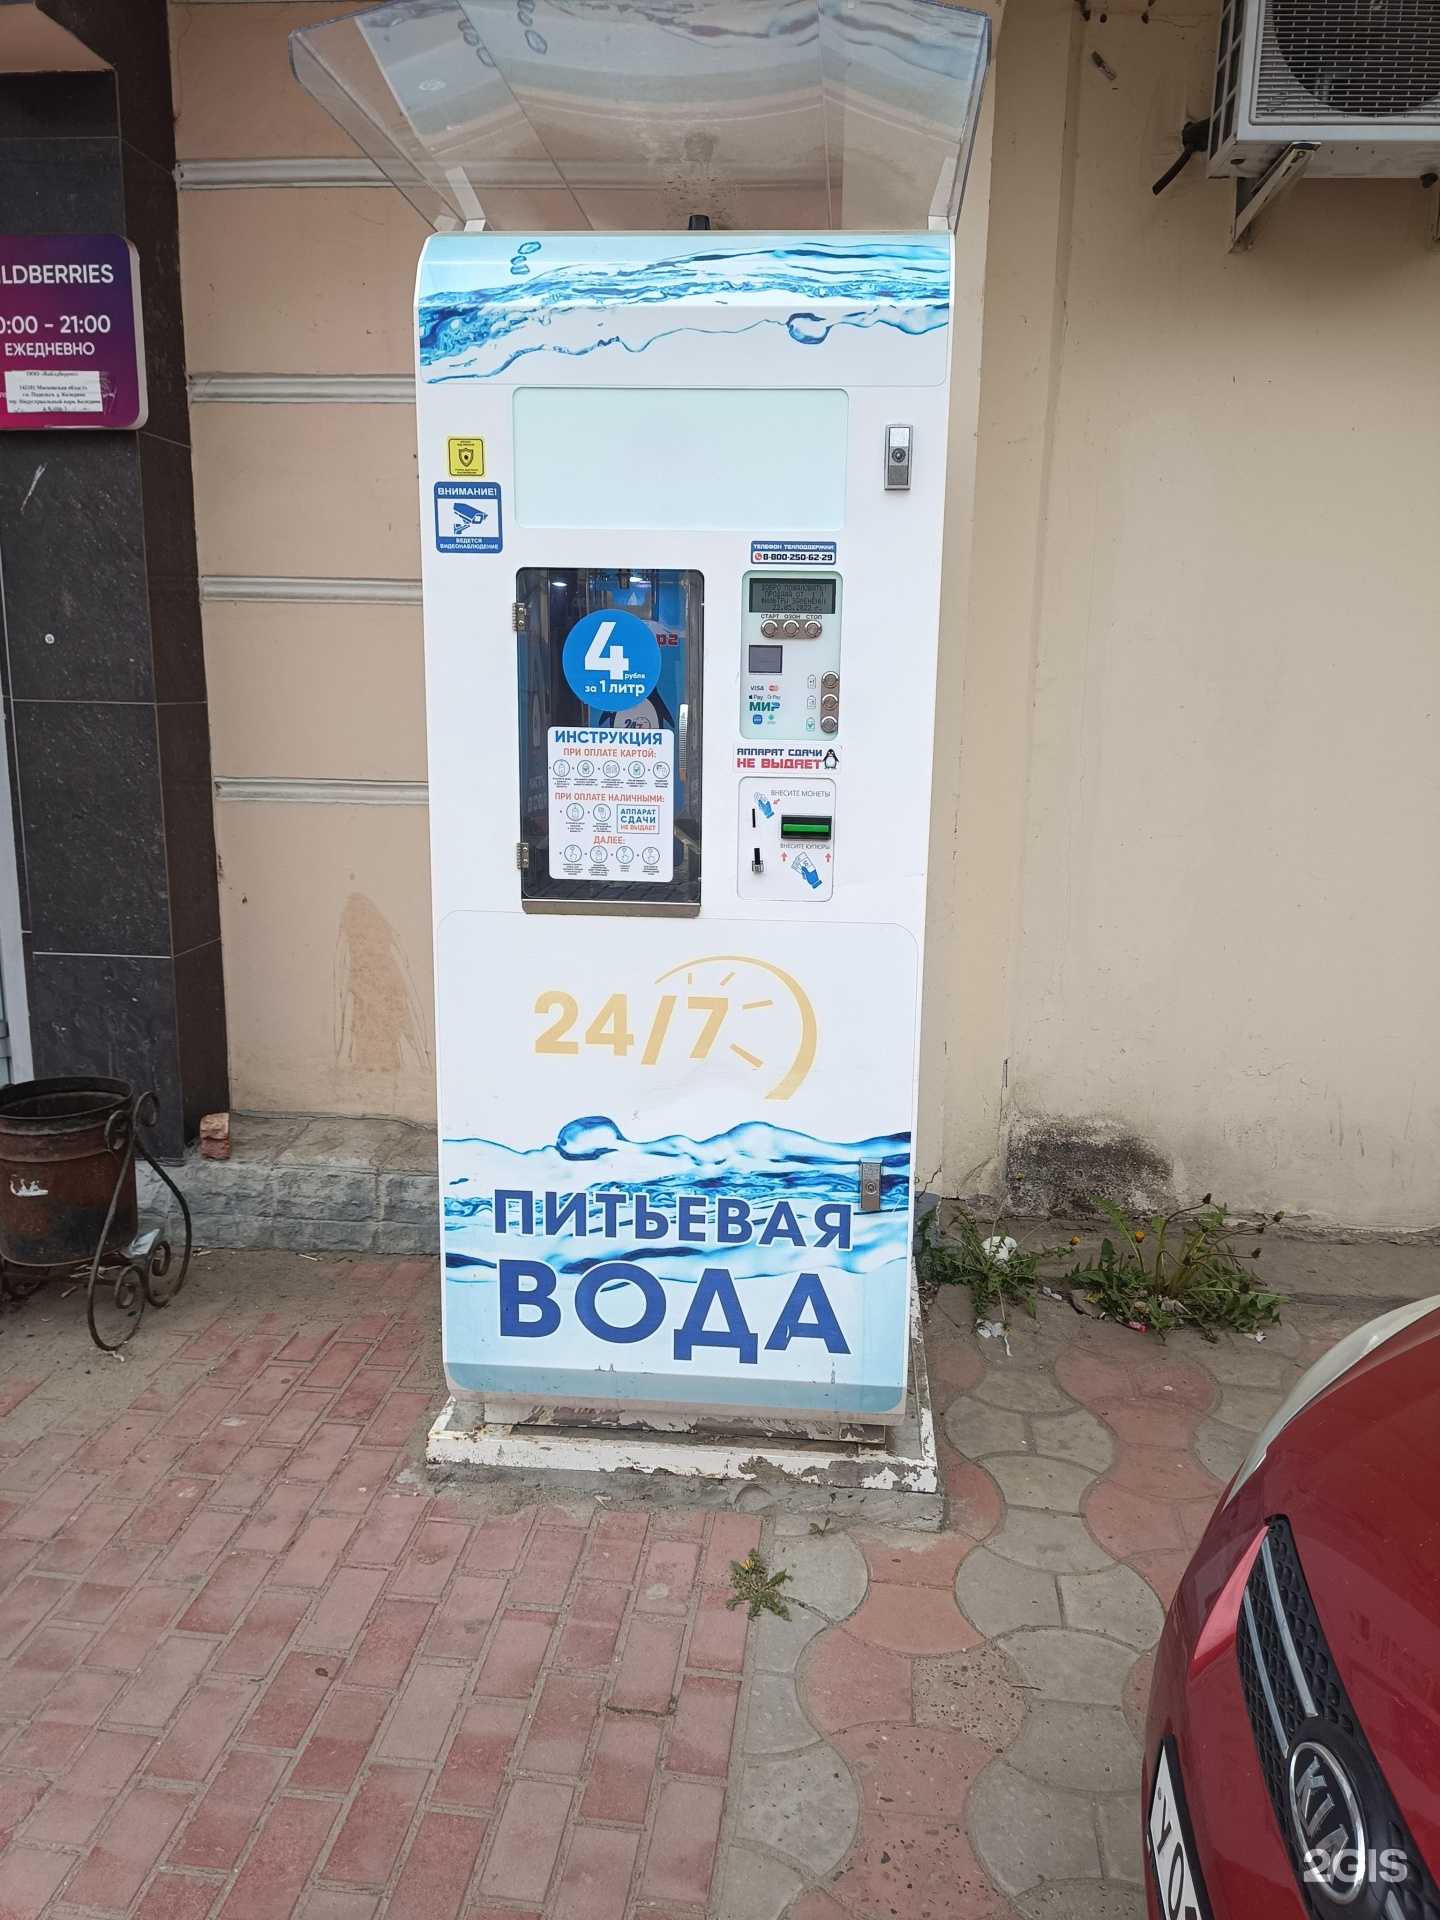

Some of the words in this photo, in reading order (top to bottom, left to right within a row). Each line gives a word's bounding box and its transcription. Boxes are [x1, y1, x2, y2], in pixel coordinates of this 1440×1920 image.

[60, 314, 111, 334] 21:00
[5, 342, 96, 357] ЕЖЕДНЕВНО
[438, 487, 496, 496] ВНИМАНИЕ!
[763, 553, 833, 561] 8-800-250-62-29
[585, 621, 629, 680] 4
[585, 685, 597, 693] за
[600, 680, 606, 693] 1
[609, 683, 645, 696] литр
[749, 702, 781, 711] МИР
[555, 730, 662, 746] ИНСТРУКЦИЯ
[564, 748, 581, 756] ПРИ
[584, 748, 617, 757] ОПЛАТЕ
[620, 748, 657, 758] КАРТОЙ:
[788, 749, 822, 757] СДАЧИ
[737, 758, 755, 768] НЕ
[761, 759, 821, 769] ВЫДАЕТ
[574, 793, 606, 801] ОПЛАТЕ
[620, 816, 656, 824] СДАЧИ
[594, 836, 625, 845] ДАЛЕЕ:
[534, 990, 728, 1066] 24/7
[494, 1189, 852, 1249] ПИТЬЕВАЯ
[499, 1259, 851, 1364] ВОДА
